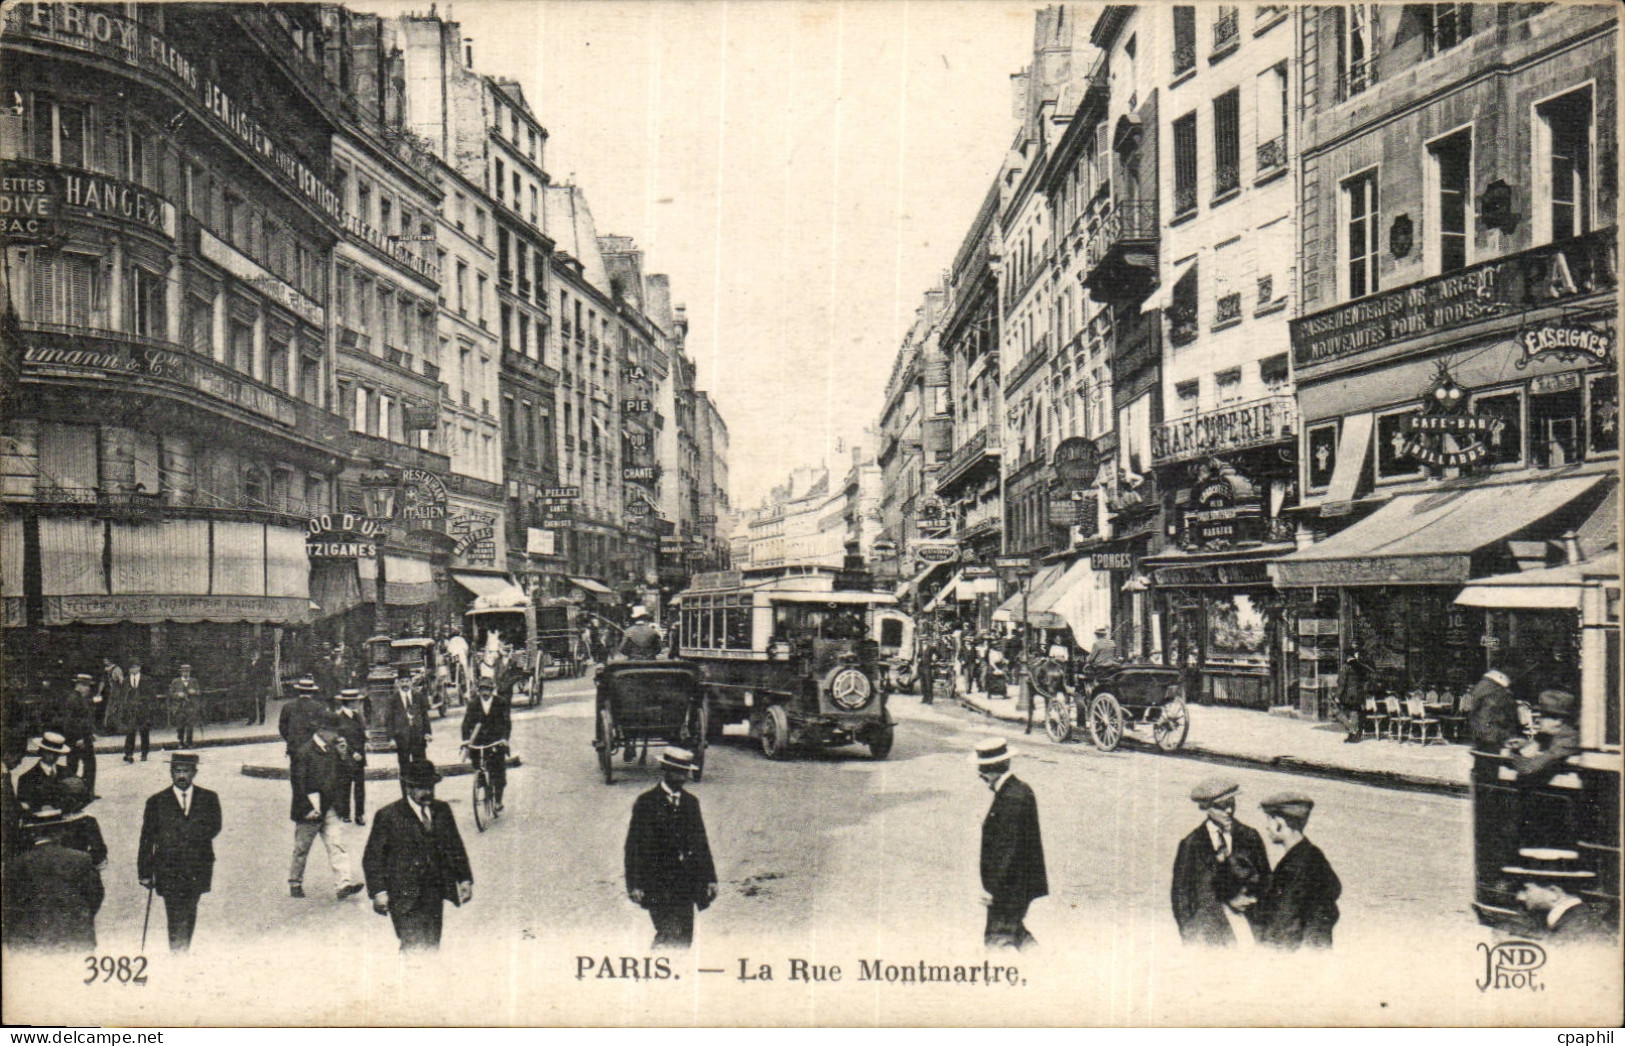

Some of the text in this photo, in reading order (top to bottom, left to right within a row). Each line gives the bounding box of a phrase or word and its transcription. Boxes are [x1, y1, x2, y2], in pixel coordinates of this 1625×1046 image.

[1391, 312, 1427, 338] POUR
[1525, 327, 1609, 358] ENSEIGNES
[627, 401, 650, 412] PIE
[623, 468, 655, 479] CHANTE
[403, 506, 444, 519] ITALIEN
[306, 542, 377, 556] TZIGANES
[1091, 553, 1132, 569] EPONGES
